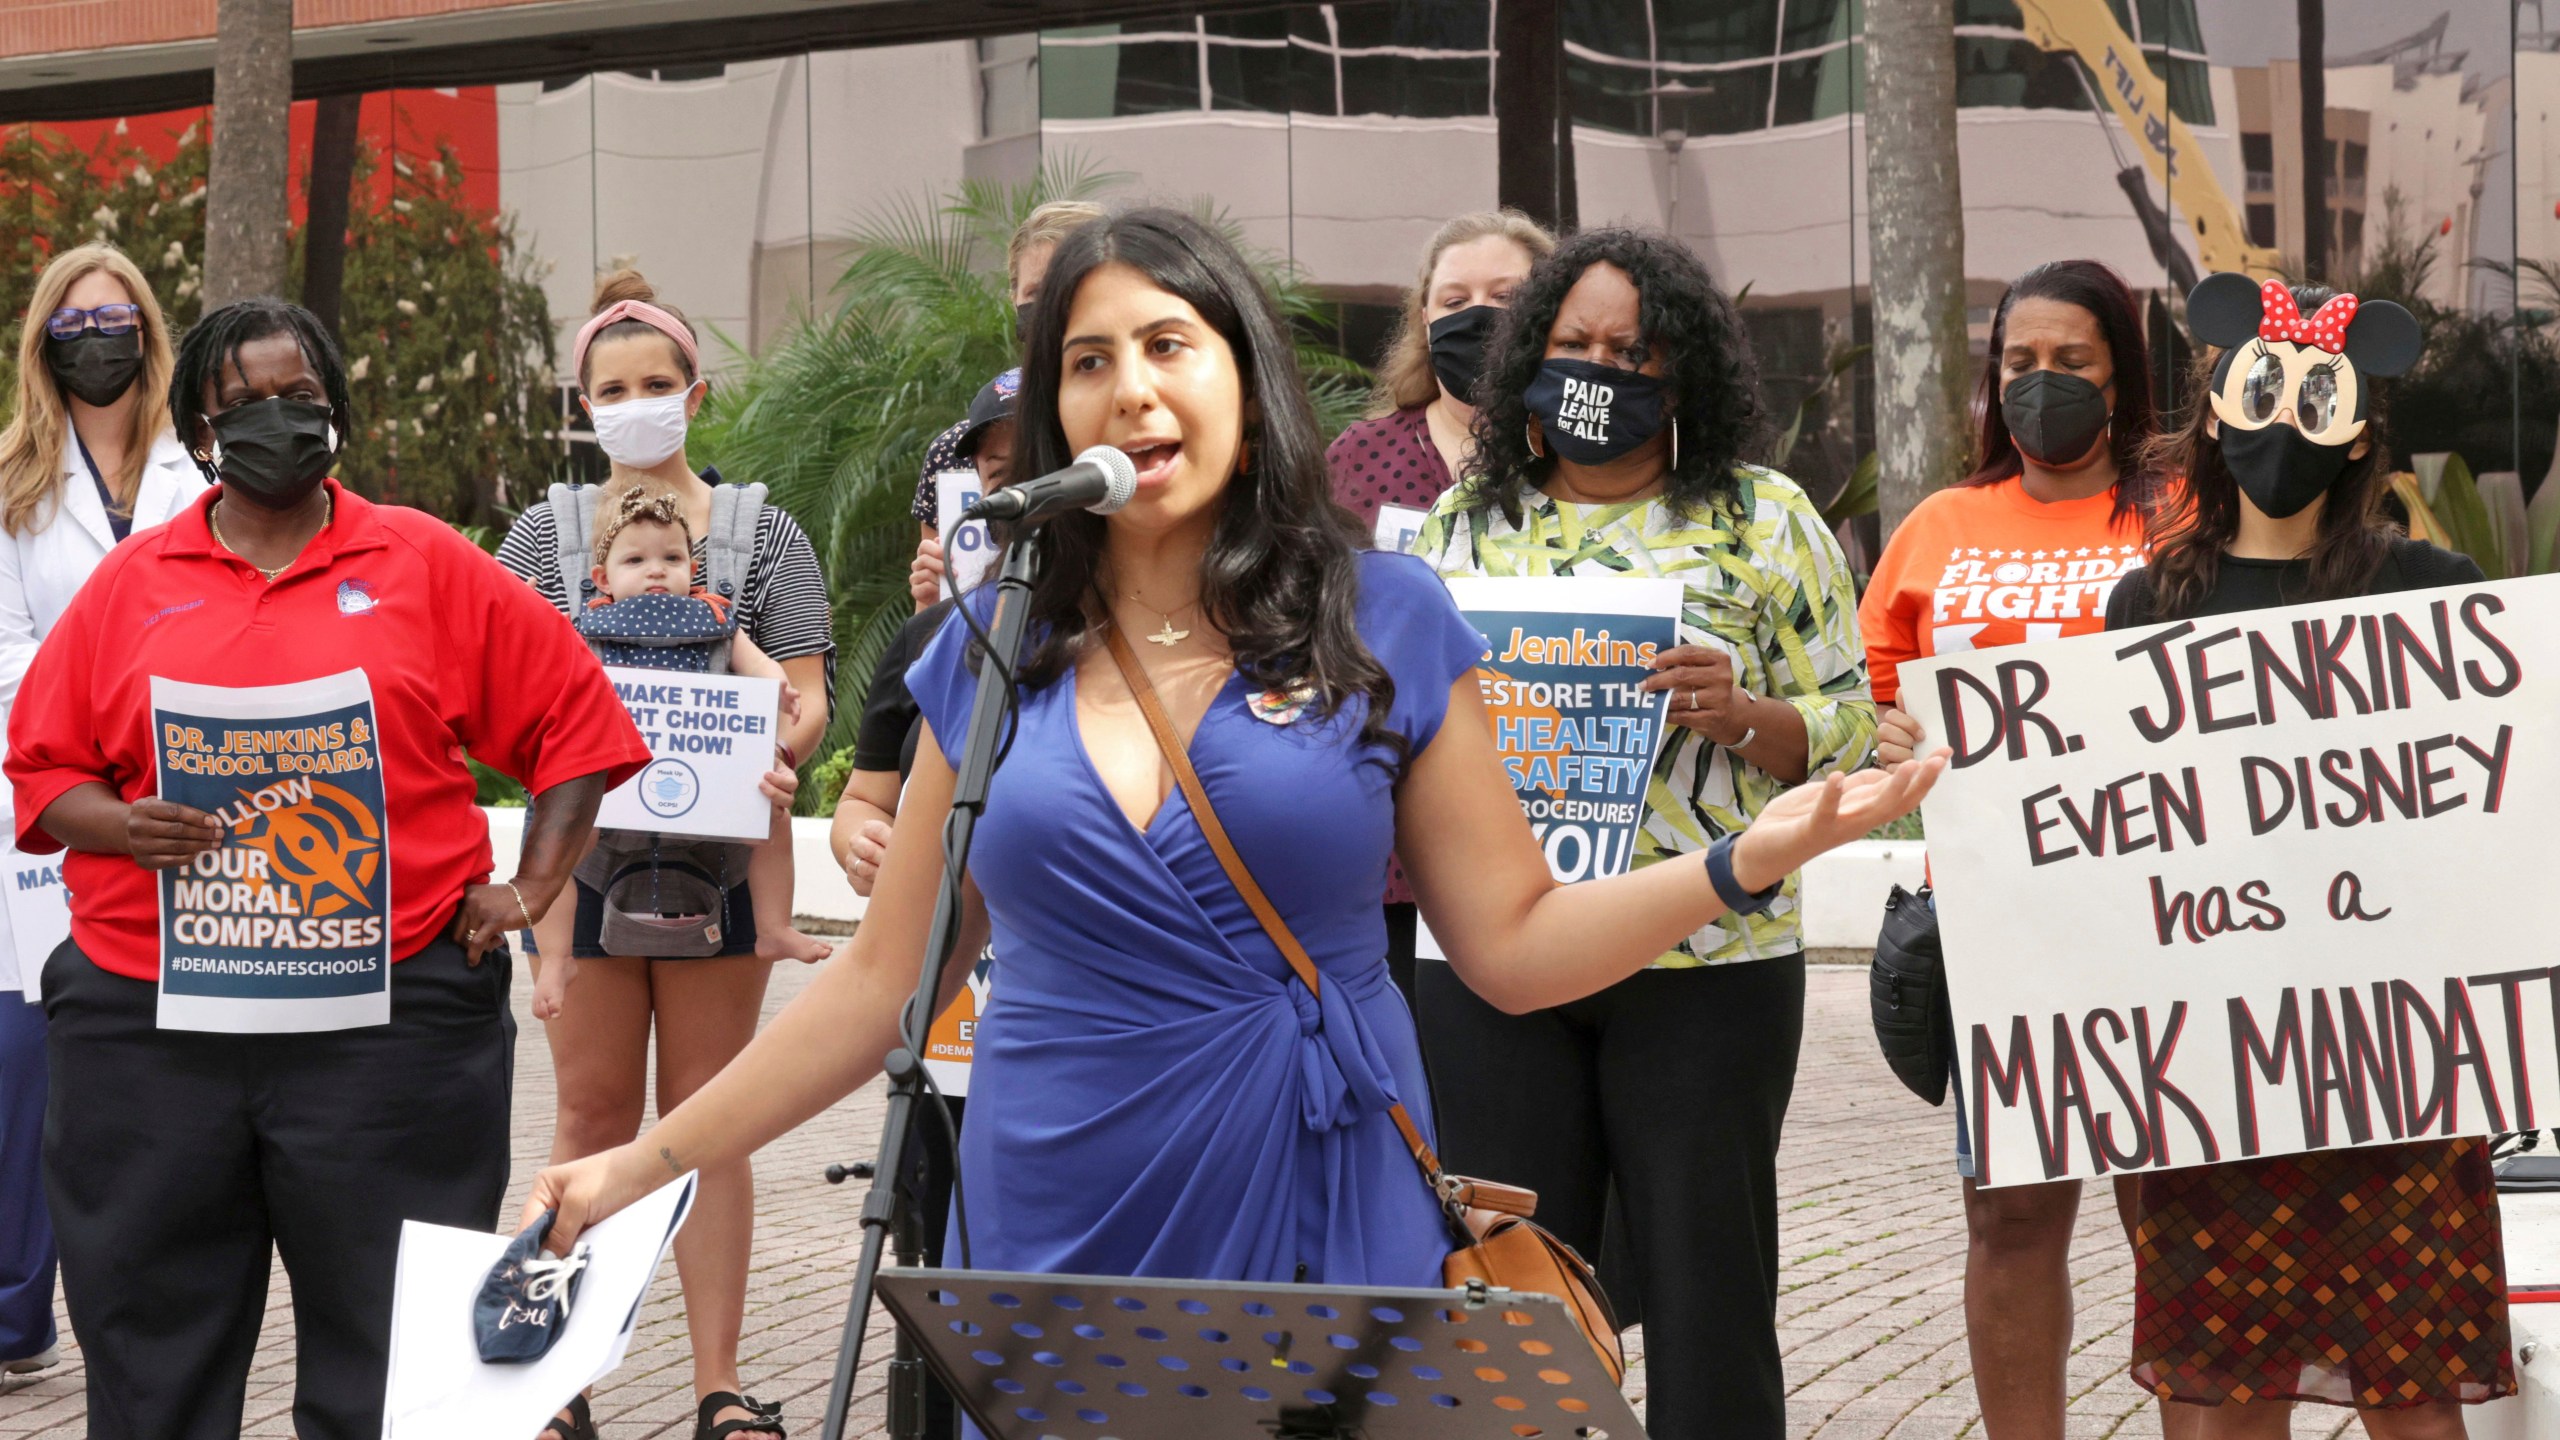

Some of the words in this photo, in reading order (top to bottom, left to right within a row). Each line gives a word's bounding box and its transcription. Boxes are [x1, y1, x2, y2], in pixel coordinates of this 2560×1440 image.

[1563, 377, 1614, 406] PAID
[1557, 417, 1573, 431] for
[1573, 421, 1609, 441] ALL
[1559, 400, 1610, 425] LEAVE
[1938, 555, 2146, 587] FLORIDA
[1500, 627, 1657, 669] Jenkins
[614, 682, 683, 705] MAKE
[690, 688, 739, 709] THE
[1479, 679, 1593, 708] ESTORE
[1936, 659, 2085, 770] DR.
[2115, 593, 2523, 743] JENKINS
[164, 723, 213, 752] DR.
[219, 722, 345, 754] JENKINS
[350, 717, 371, 744] &
[666, 709, 766, 734] CHOICE!
[1496, 716, 1651, 755] HEALTH
[668, 733, 732, 755] NOW!
[167, 750, 273, 776] SCHOOL
[277, 747, 373, 773] BOARD,
[1502, 756, 1647, 795] SAFETY
[213, 775, 313, 828] LLOW
[1521, 799, 1636, 824] ROCEDURES
[2021, 766, 2207, 867] EVEN
[2241, 724, 2513, 836] DISNEY
[174, 879, 301, 914] MORAL
[2149, 875, 2286, 946] has
[2327, 871, 2392, 921] a
[173, 913, 382, 949] COMPASSES
[172, 957, 377, 976] #DEMANDSAFESCHOOLS
[1972, 1000, 2220, 1187] MASK
[2227, 965, 2560, 1157] MANDAT
